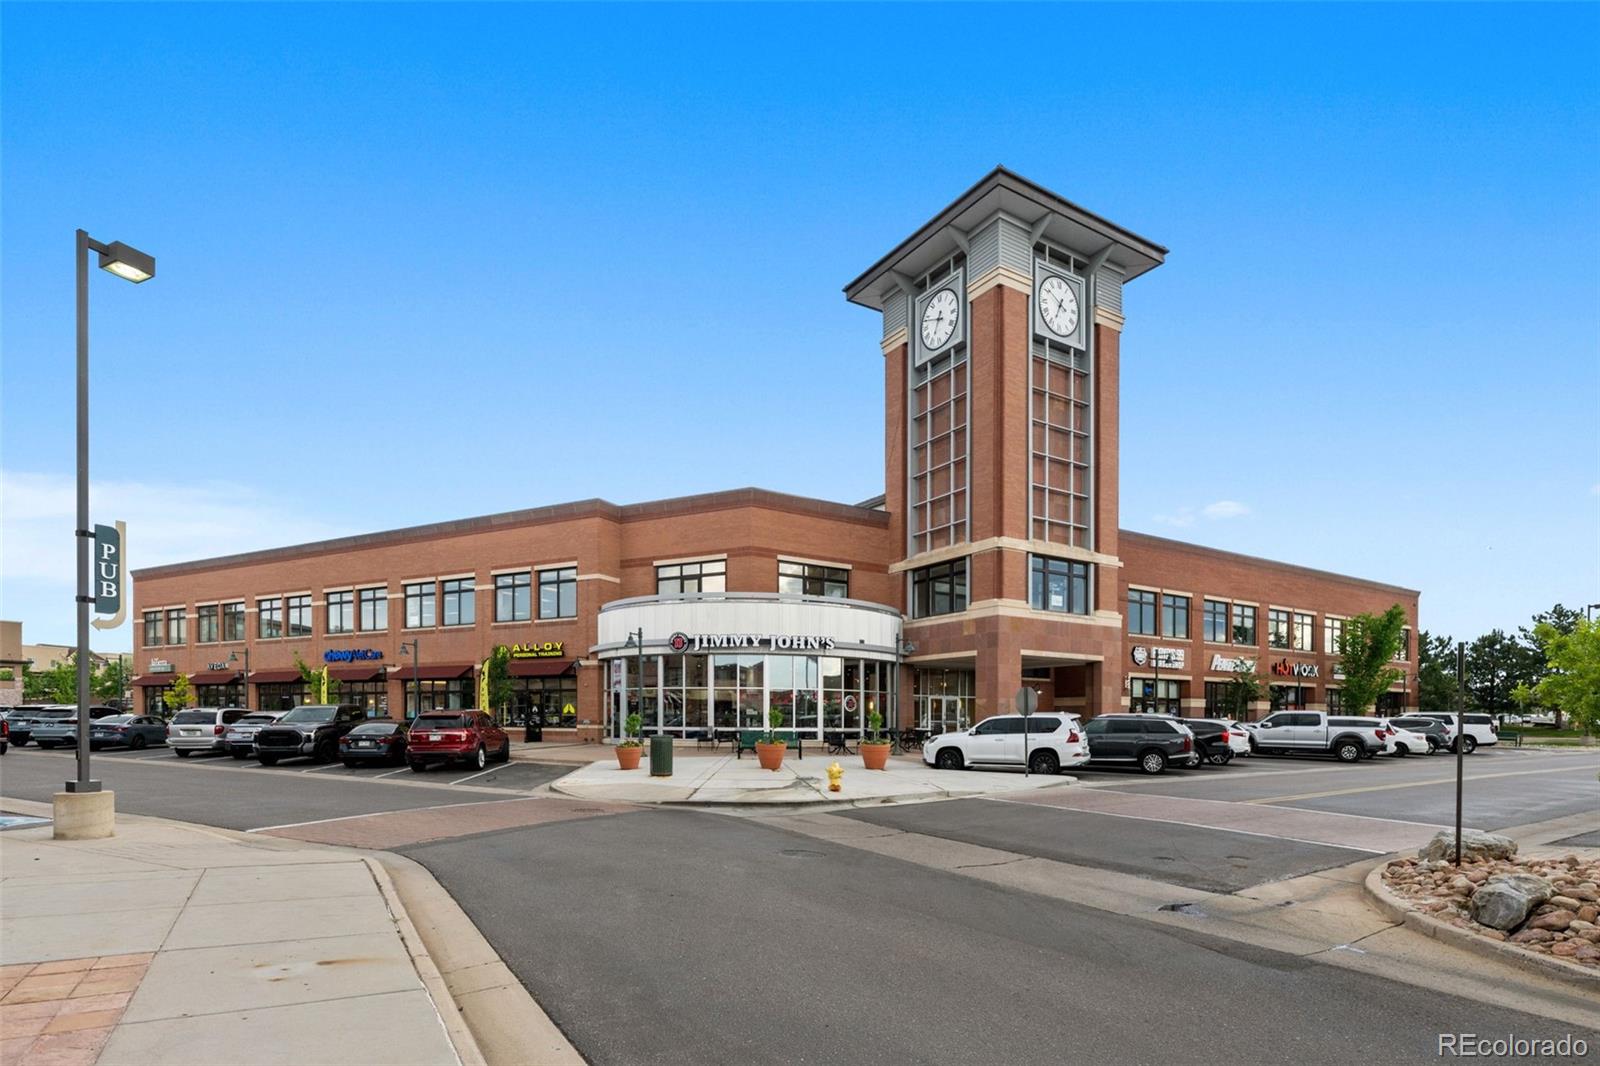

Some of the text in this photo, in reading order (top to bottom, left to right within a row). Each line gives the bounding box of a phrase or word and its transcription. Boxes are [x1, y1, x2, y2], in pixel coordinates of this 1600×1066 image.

[99, 542, 118, 598] PUB
[513, 642, 563, 652] ALLOY
[694, 634, 762, 651] JIMMY
[770, 635, 835, 651] JOHN'S
